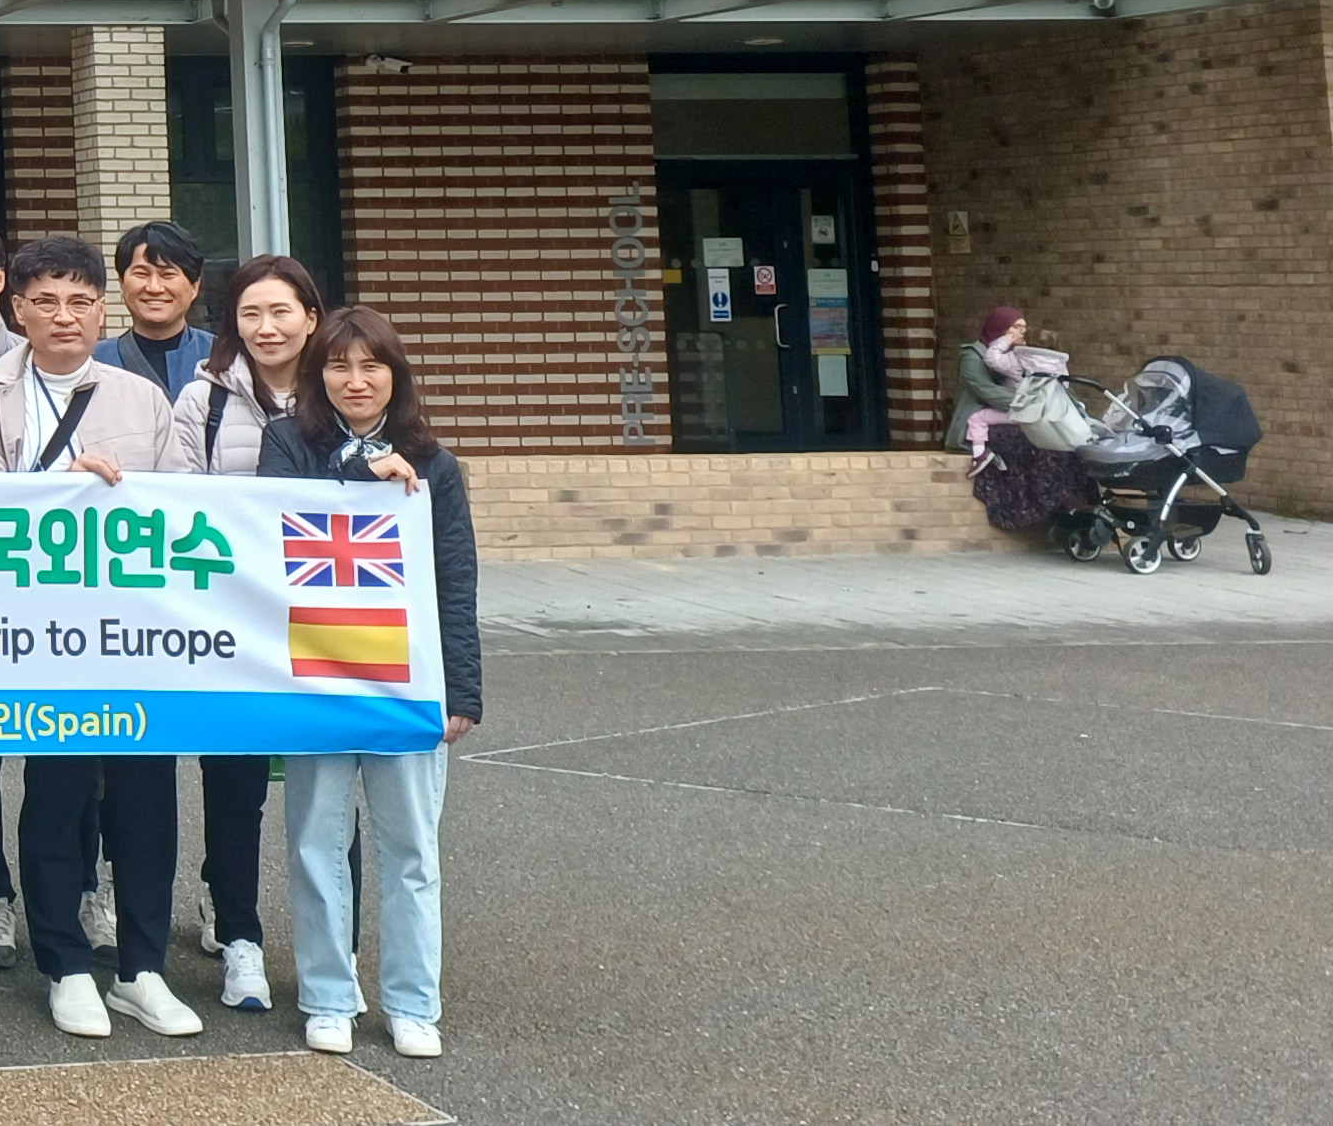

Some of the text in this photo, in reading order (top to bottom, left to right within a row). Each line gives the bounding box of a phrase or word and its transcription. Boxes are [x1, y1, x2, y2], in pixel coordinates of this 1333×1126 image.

[608, 181, 656, 446] PRE-SCHOOL
[46, 623, 87, 657] to
[100, 618, 237, 664] Europe
